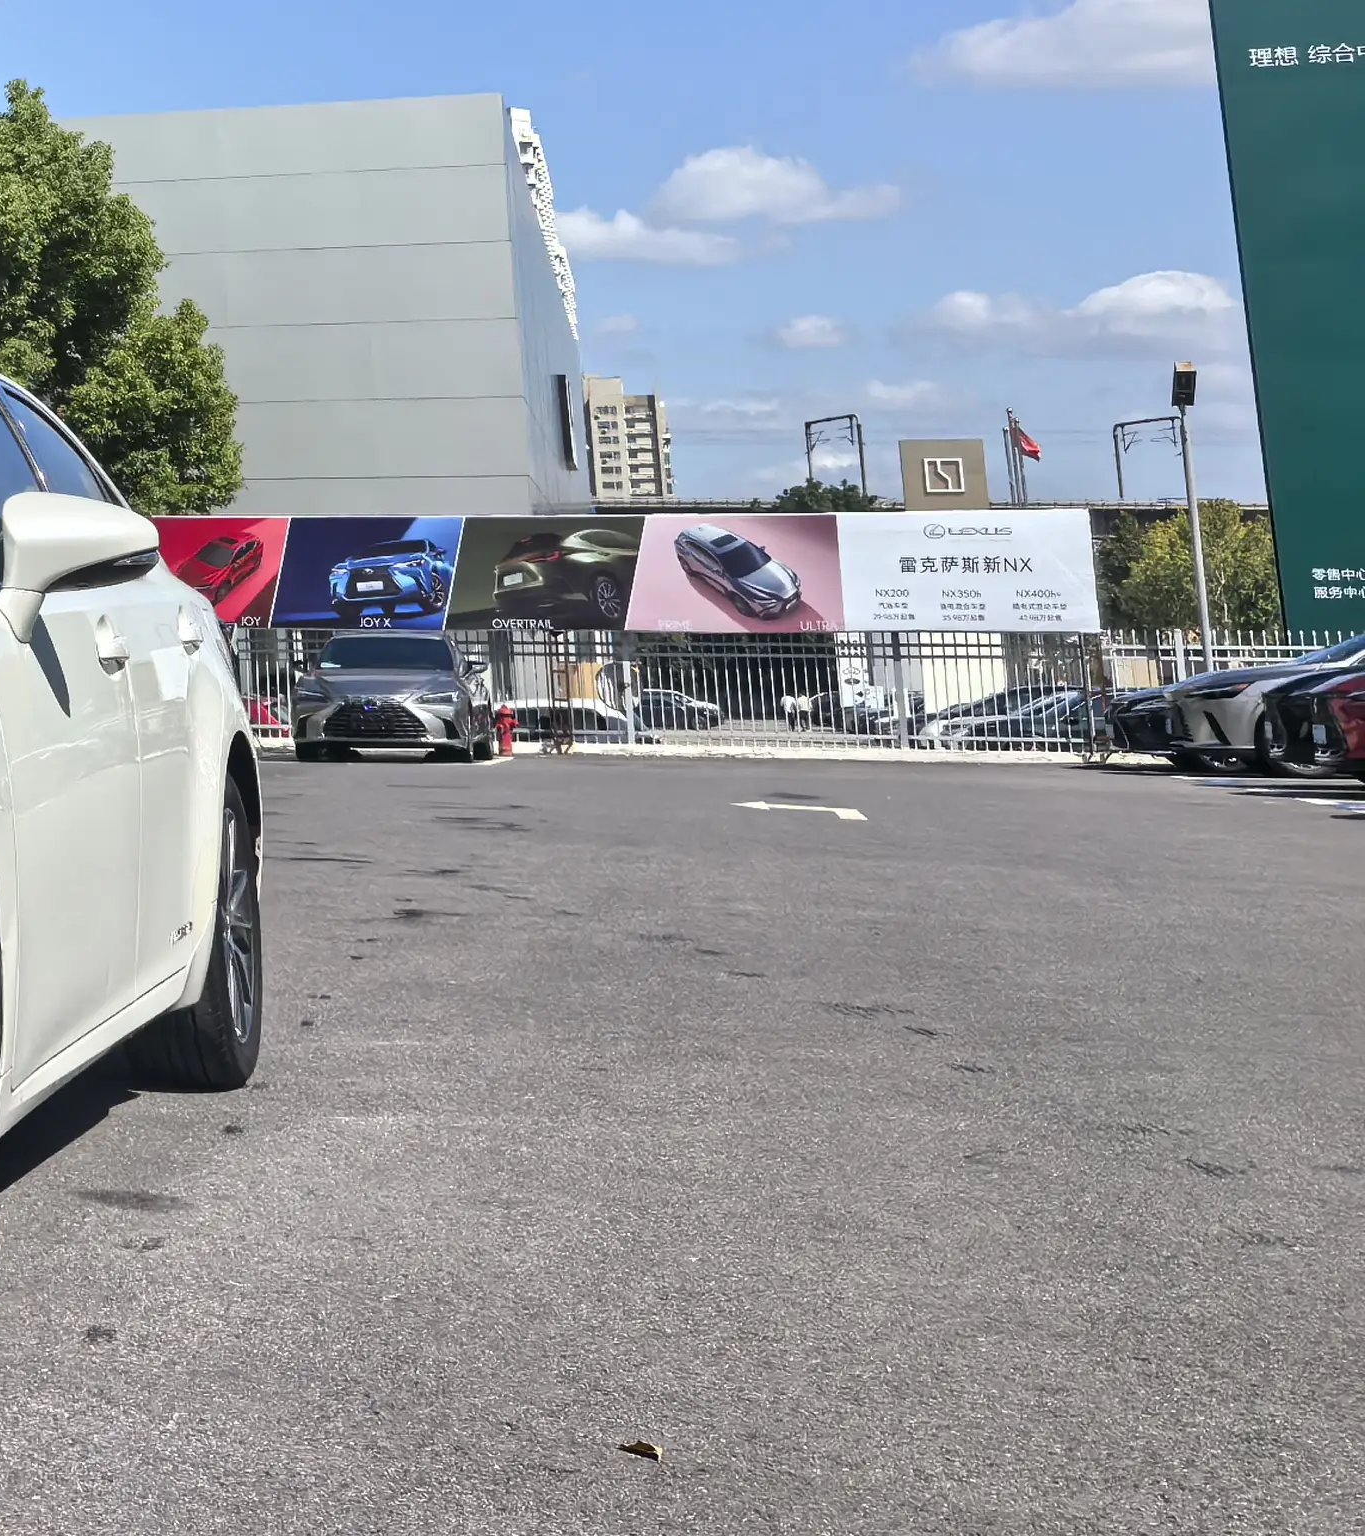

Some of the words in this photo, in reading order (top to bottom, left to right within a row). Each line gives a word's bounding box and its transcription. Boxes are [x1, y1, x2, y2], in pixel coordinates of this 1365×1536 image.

[1249, 46, 1299, 67] 理想
[948, 527, 1013, 536] LEXUS
[899, 556, 1034, 574] 雷克萨斯新NX
[875, 589, 910, 598] NX200
[942, 589, 982, 599] NX350h
[241, 616, 261, 627] JOY
[359, 617, 382, 628] JOY
[383, 617, 392, 628] X
[492, 617, 554, 630] OVERTRAIL
[799, 621, 838, 631] ULTRA
